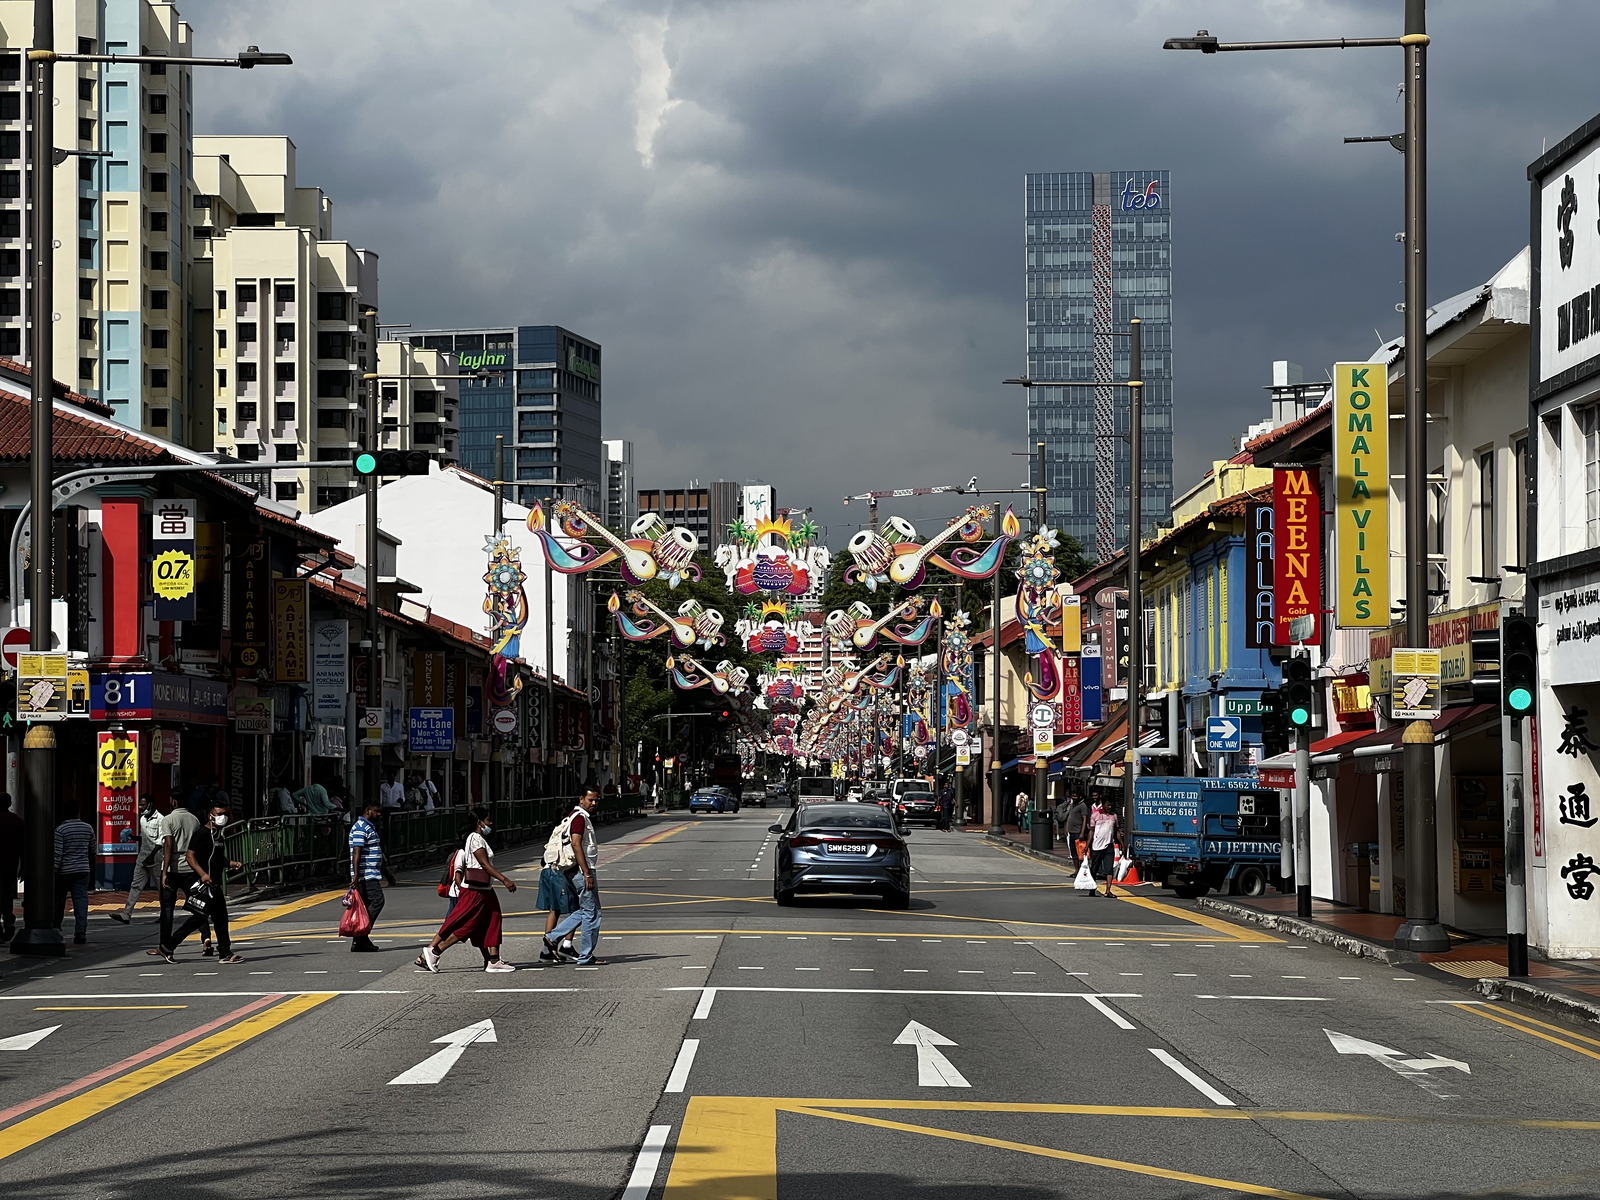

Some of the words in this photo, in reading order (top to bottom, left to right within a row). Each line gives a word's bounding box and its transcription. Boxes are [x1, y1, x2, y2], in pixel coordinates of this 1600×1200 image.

[1348, 368, 1372, 499] KOMALA
[158, 503, 189, 534] 當
[1282, 470, 1312, 605] MEENA
[1351, 509, 1373, 619] VILAS
[245, 560, 255, 641] ABIRAAME
[1288, 607, 1307, 615] Gold
[286, 604, 297, 677] ABIRAAME
[1105, 611, 1114, 671] COSTUME
[243, 651, 256, 662] 85
[424, 652, 433, 705] MONEYMAX
[104, 679, 135, 704] 81
[528, 687, 540, 747] GOODAY
[1228, 701, 1251, 714] Upp
[411, 717, 428, 729] Bus
[430, 717, 452, 729] Lane
[101, 748, 135, 770] 0.7%
[1138, 791, 1145, 800] AJ
[1146, 791, 1172, 800] JETTING
[1173, 791, 1186, 800] PTE
[1187, 791, 1198, 800] LTD
[1203, 780, 1226, 789] TEL:
[1228, 781, 1250, 789] 6562
[1138, 806, 1157, 815] TEL:
[1157, 807, 1177, 816] 6562
[1178, 808, 1198, 816] 6161
[1207, 841, 1222, 853] AJ
[1227, 841, 1281, 853] JETTING
